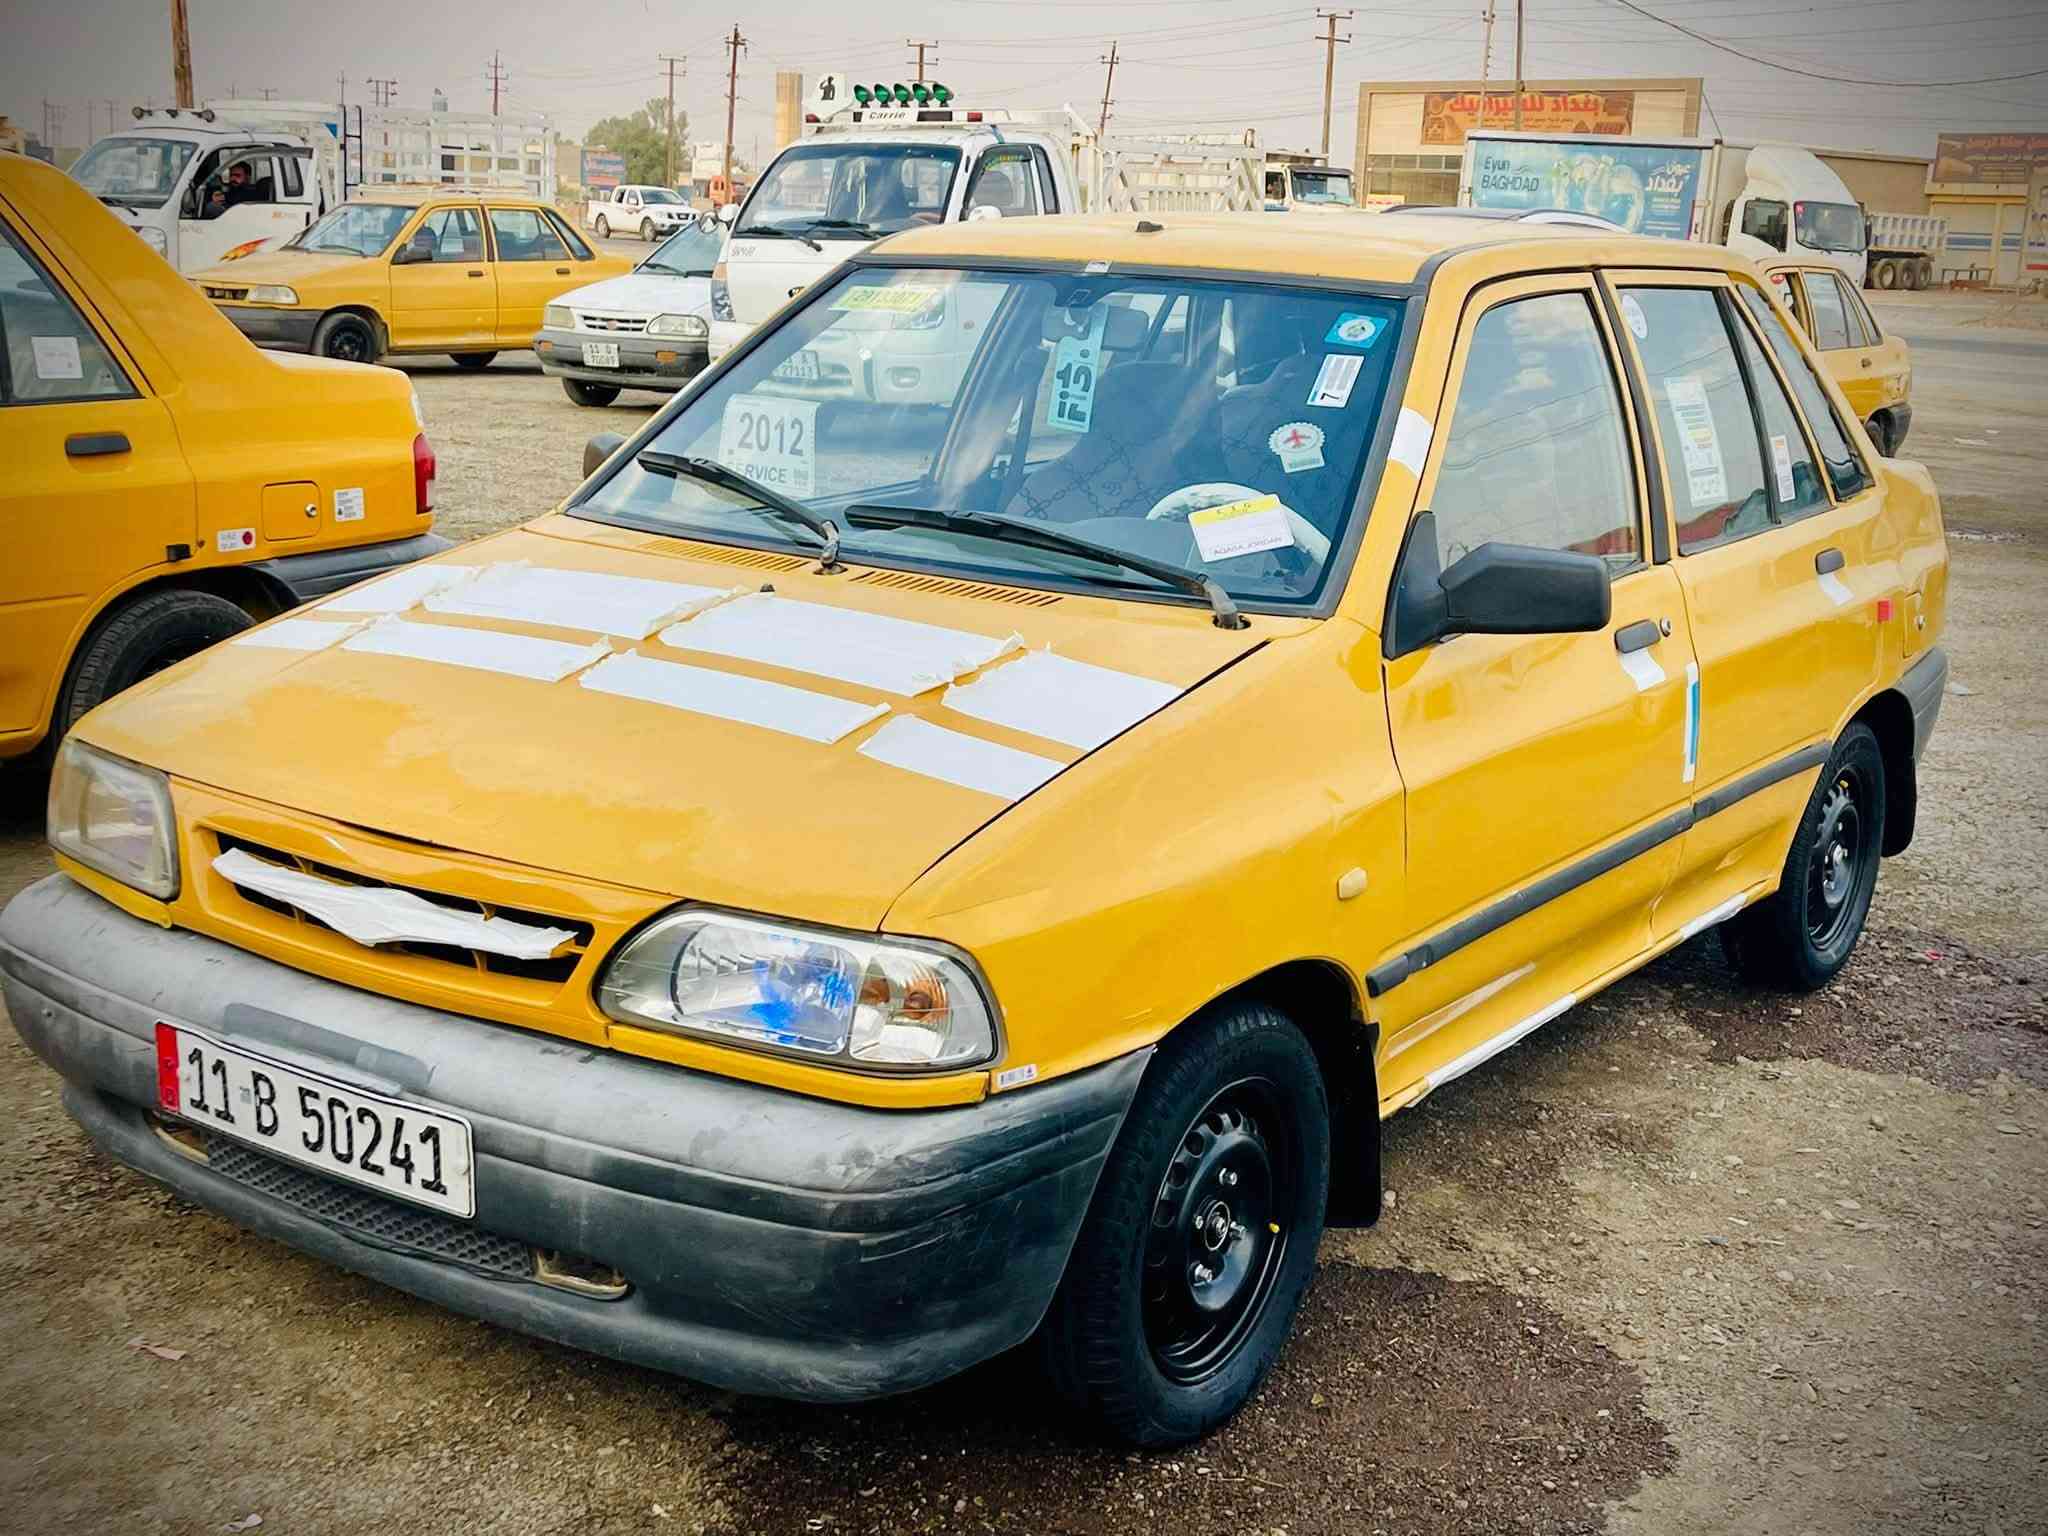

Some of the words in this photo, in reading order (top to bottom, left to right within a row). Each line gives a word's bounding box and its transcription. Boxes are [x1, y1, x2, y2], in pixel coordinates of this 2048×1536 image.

[1551, 93, 1600, 116] بغداد
[1483, 156, 1511, 174] Eyun
[1481, 174, 1540, 192] BAGHDAD
[737, 411, 804, 457] 2012
[189, 1047, 235, 1124] 11
[252, 1070, 279, 1137] B
[298, 1085, 447, 1196] 50241
